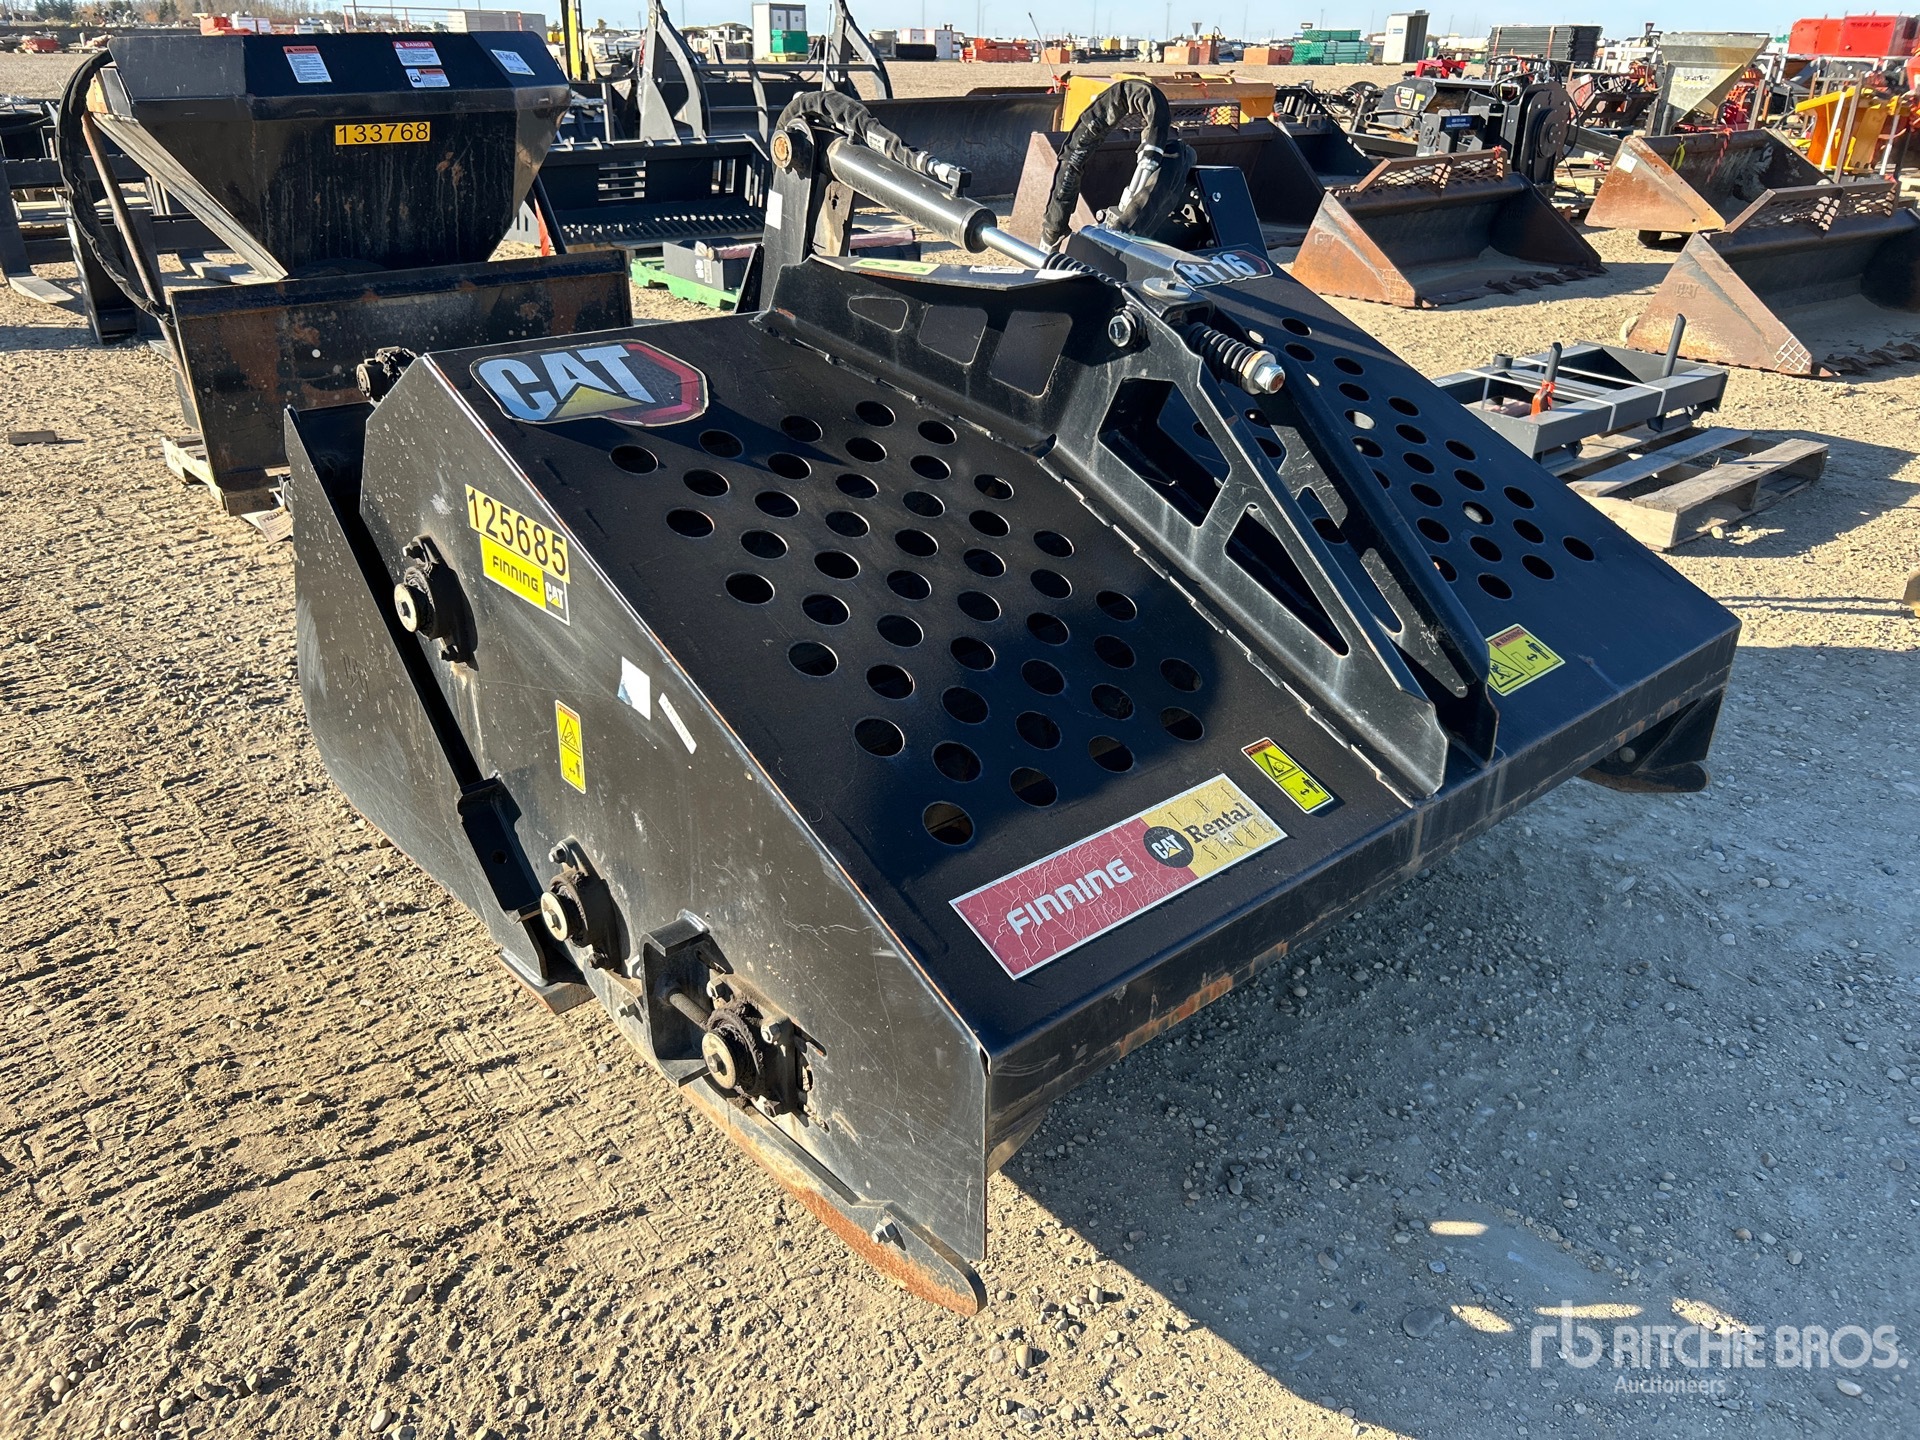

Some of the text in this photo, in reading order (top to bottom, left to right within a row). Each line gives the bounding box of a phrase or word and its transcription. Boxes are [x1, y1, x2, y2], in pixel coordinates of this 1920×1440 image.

[338, 122, 428, 143] 133768
[1675, 282, 1700, 299] CAT
[478, 344, 657, 420] CAT
[468, 489, 567, 577] 125685
[492, 555, 564, 609] FINNING CAT
[1006, 801, 1253, 936] FINNING CAT Rental
